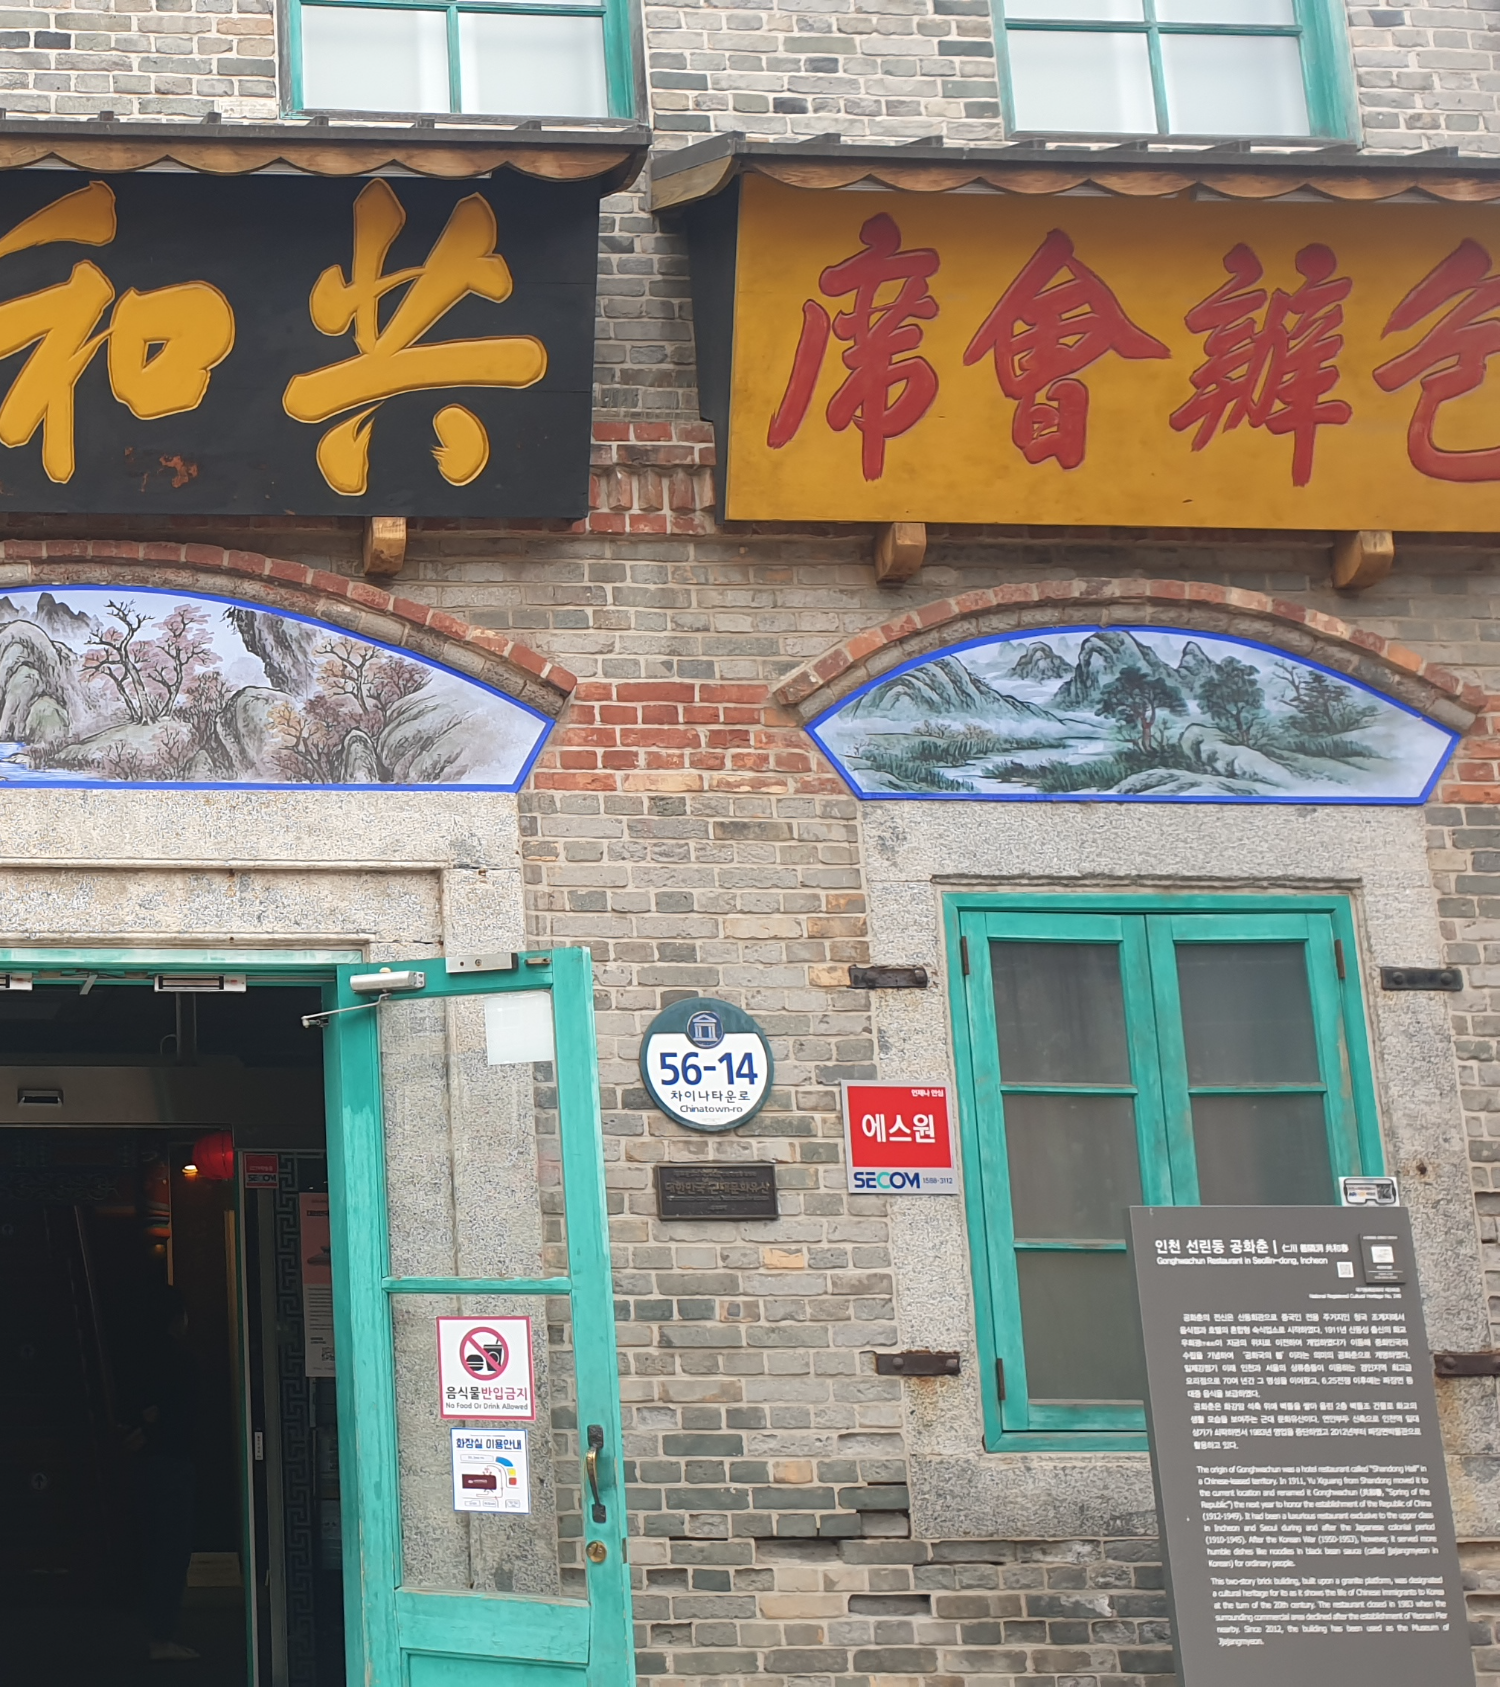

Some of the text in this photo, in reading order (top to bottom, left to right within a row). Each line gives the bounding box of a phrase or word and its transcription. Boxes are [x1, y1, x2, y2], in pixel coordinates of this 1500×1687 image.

[660, 1052, 758, 1085] 56-14
[671, 1089, 750, 1104] 차이나타운로
[680, 1104, 743, 1113] Chinatown-ro
[862, 1114, 935, 1143] 에스원
[854, 1172, 920, 1189] SECOM
[1155, 1240, 1181, 1254] 인천
[1186, 1240, 1224, 1254] 선린동
[1230, 1239, 1268, 1254] 공화춘
[446, 1401, 455, 1409] No
[457, 1402, 472, 1410] Food
[484, 1402, 500, 1410] Drink
[502, 1402, 528, 1411] Allowed
[457, 1437, 521, 1450] 화장실 이용안내
